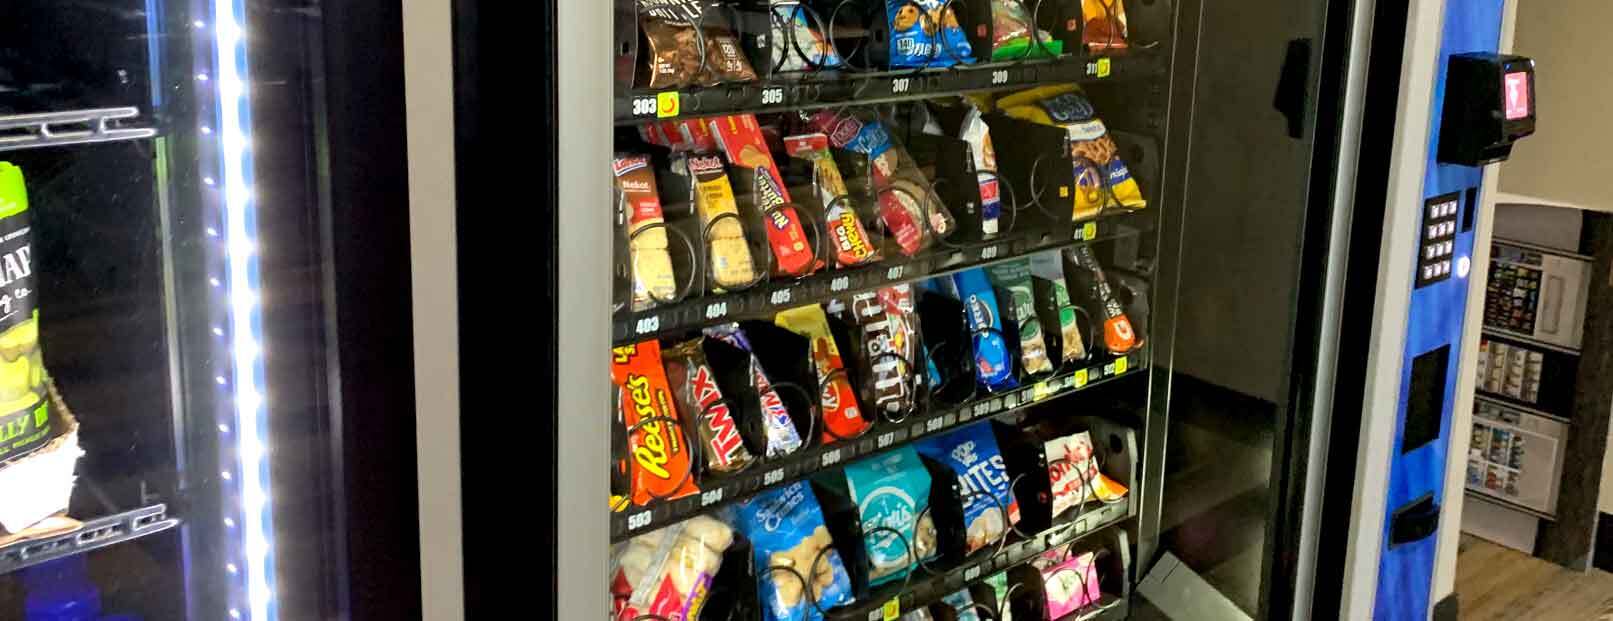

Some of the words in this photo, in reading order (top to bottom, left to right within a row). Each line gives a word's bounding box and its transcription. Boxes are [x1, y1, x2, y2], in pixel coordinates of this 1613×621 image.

[892, 78, 909, 92] 307
[762, 88, 783, 104] 305
[633, 98, 657, 114] 303
[771, 288, 791, 305] 405
[706, 302, 727, 319] 404
[636, 316, 660, 334] 403
[693, 365, 743, 466] TWIX
[878, 432, 894, 448] 507
[764, 468, 784, 486] 505
[701, 488, 722, 506] 504
[628, 511, 652, 530] 503
